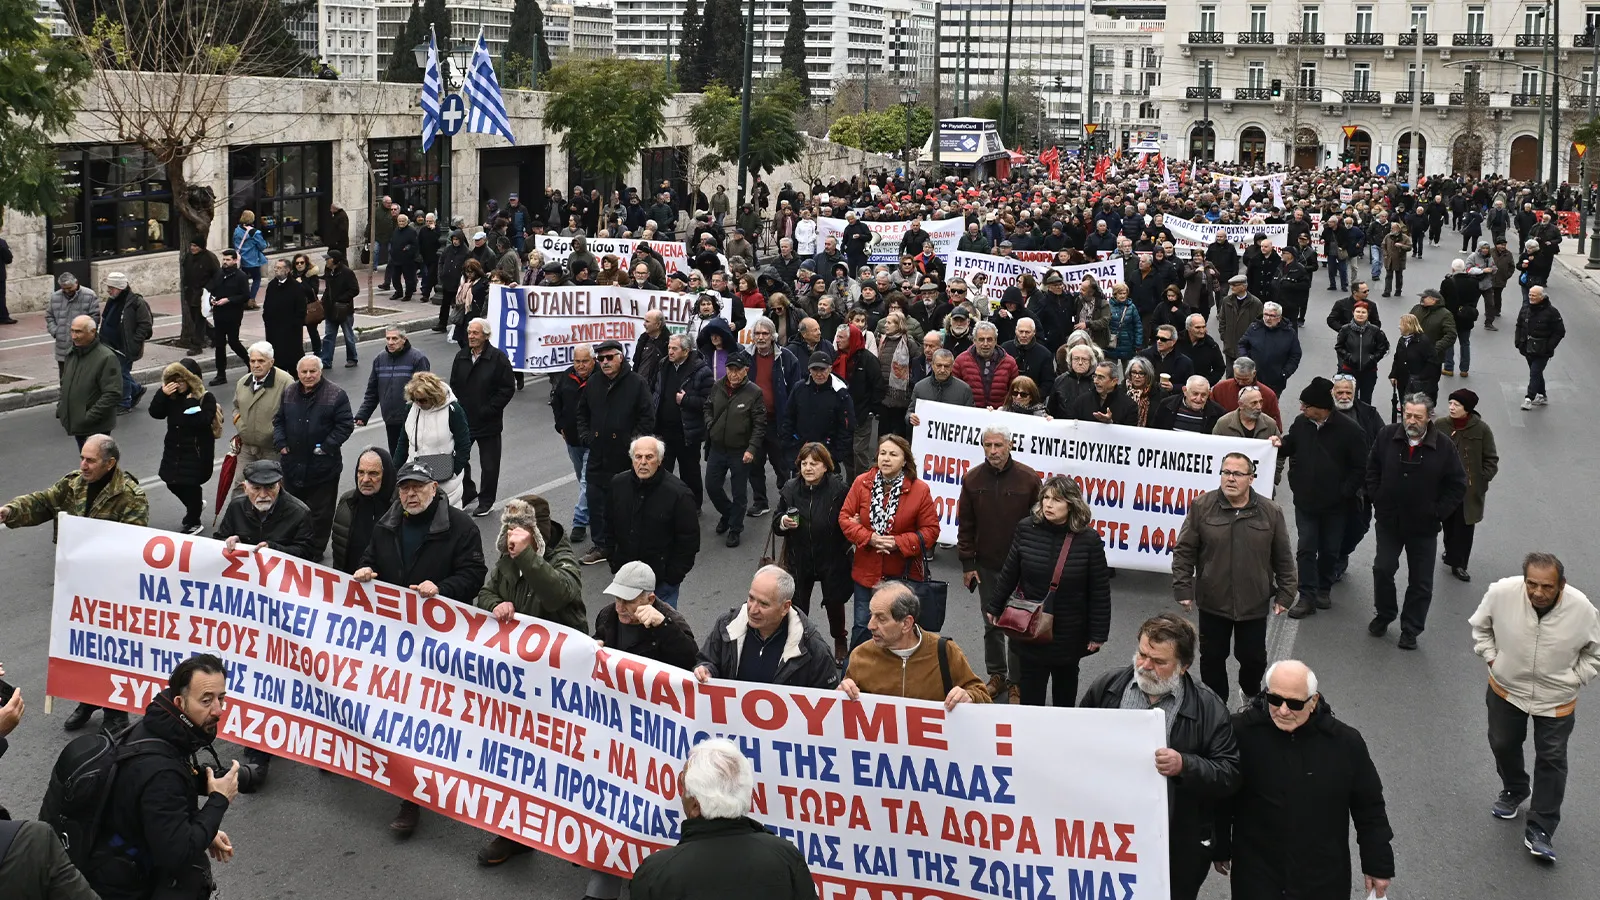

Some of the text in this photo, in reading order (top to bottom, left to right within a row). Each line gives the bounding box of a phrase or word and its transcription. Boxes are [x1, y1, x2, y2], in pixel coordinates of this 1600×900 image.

[1164, 216, 1199, 232] ΣΥΛΛΟΓΟΣ
[542, 238, 573, 255] Φέρτ
[954, 256, 962, 267] Η
[527, 291, 590, 315] ΦΤΑΝΕΙ
[600, 296, 623, 315] ΠΙΑ
[630, 299, 638, 316] Η
[571, 322, 635, 341] ΣΥΝΤΑΞΕΩΝ
[1030, 435, 1132, 466] ΣΥΝΤΑΞΙΟΥΧΙΚΕΣ
[1137, 447, 1213, 474] ΟΡΓΑΝΩΣΕΙΣ
[142, 535, 193, 573] ΟΙ
[221, 547, 568, 669] ΣΥΝΤΑΞΙΟΥΧΟΙ
[591, 649, 948, 751] ΑΠΑΙΤΟΥΜΕ
[139, 573, 172, 605] ΝΑ
[180, 579, 319, 639] ΣΤΑΜΑΤΗΣΕΙ
[325, 612, 387, 658] ΤΩΡΑ
[396, 630, 415, 663] Ο
[420, 636, 526, 700] ΠΟΛΕΜΟΣ
[551, 676, 623, 733] ΚΑΜΙΑ
[772, 740, 840, 784] ΤΗΣ
[851, 750, 1016, 805] ΕΛΛΑΔΑΣ
[69, 595, 180, 641] ΑΥΞΗΣΕΙΣ
[188, 615, 260, 659] ΣΤΟΥΣ
[265, 633, 363, 692] ΜΙΣΘΟΥΣ
[366, 663, 413, 705] ΚΑΙ
[419, 676, 456, 718] ΤΙΣ
[460, 689, 587, 763] ΣΥΝΤΑΞΕΙΣ
[607, 738, 638, 785] ΝΑ
[777, 785, 872, 832] ΤΩΡΑ
[881, 797, 929, 837] ΤΑ
[940, 805, 1042, 855] ΔΩΡΑ
[1054, 818, 1138, 864] ΜΑΣ
[69, 628, 144, 669] ΜΕΙΩΣΗ
[253, 671, 286, 705] ΤΩΝ
[290, 678, 371, 736] ΒΑΣΙΚΩΝ
[372, 708, 462, 763] ΑΓΑΘΩΝ
[478, 737, 547, 793] ΜΕΤΡΑ
[554, 763, 681, 841] ΠΡΟΣΤΑΣΙΑΣ
[853, 843, 898, 878] ΚΑΙ
[907, 849, 960, 887] ΤΗΣ
[968, 855, 1056, 900] ΖΩΗΣ
[1068, 868, 1138, 900] ΜΑΣ
